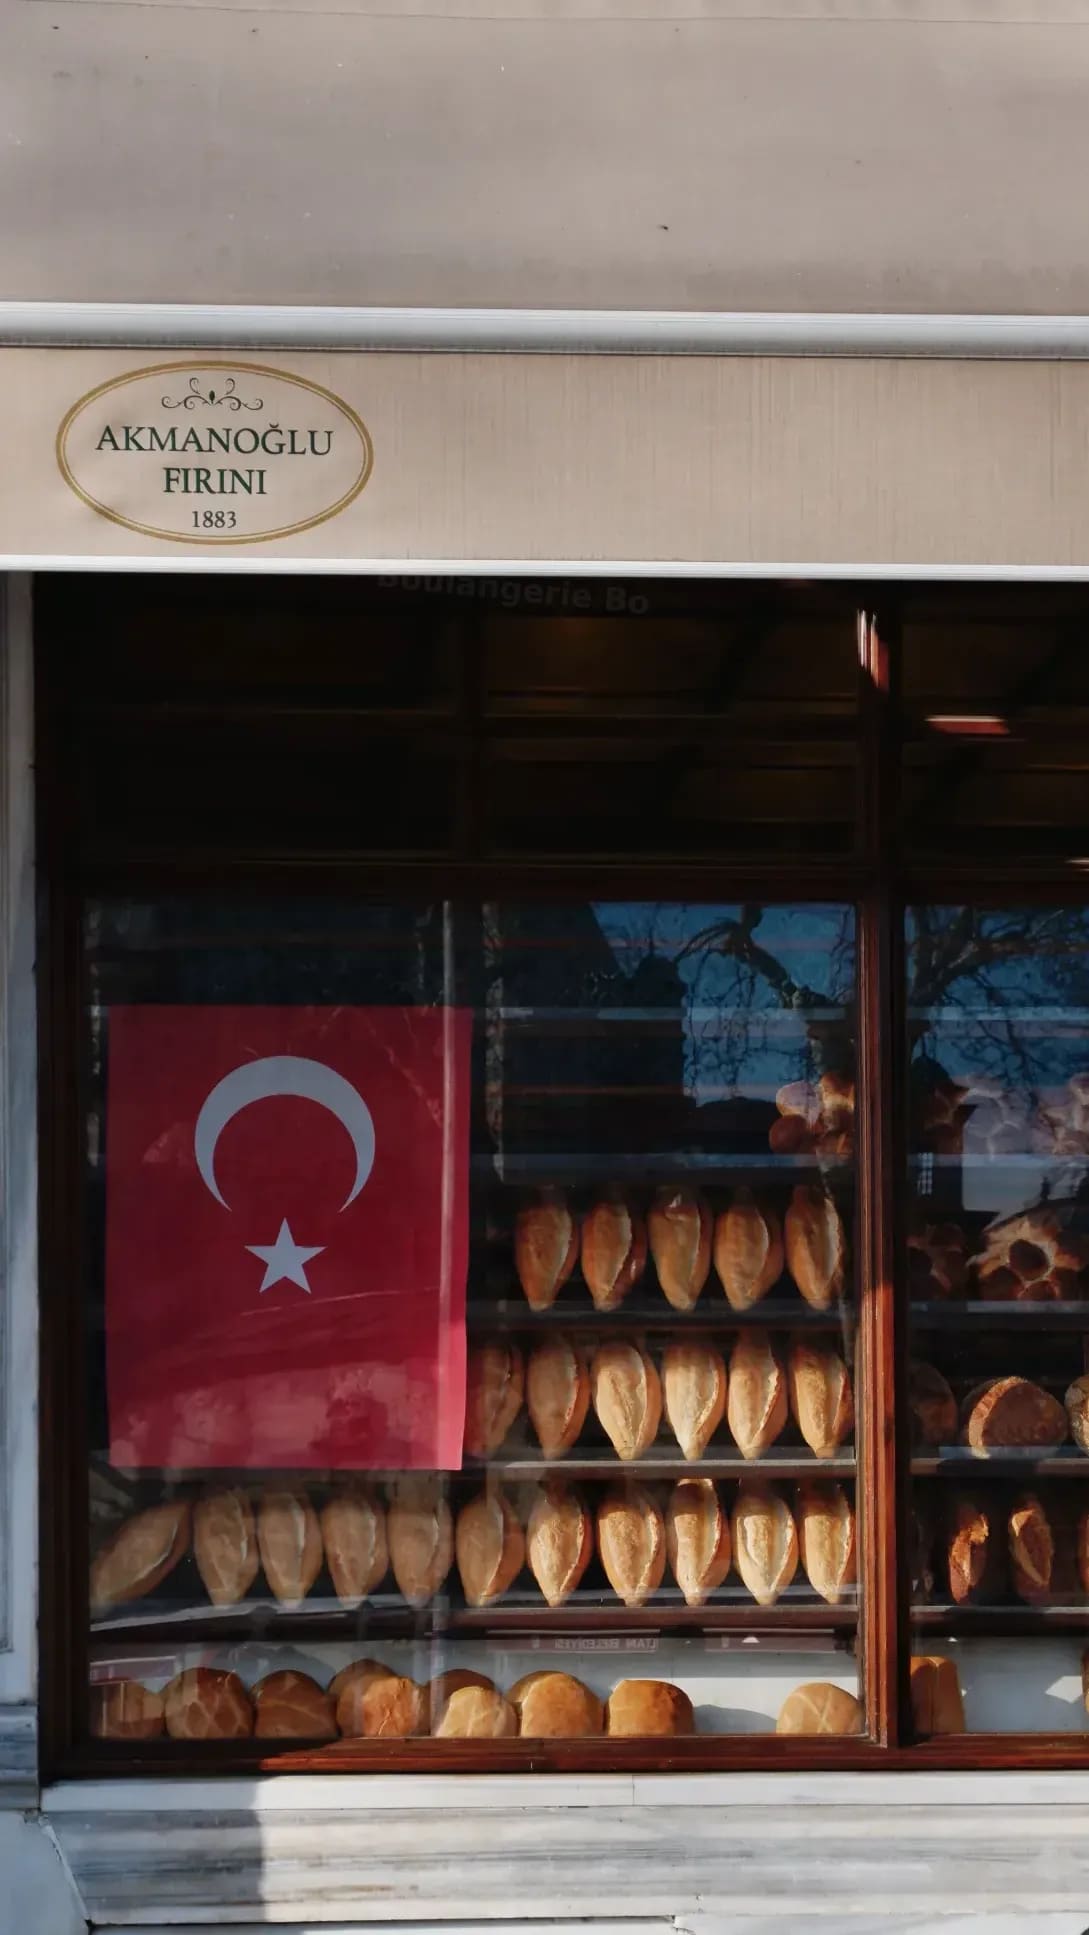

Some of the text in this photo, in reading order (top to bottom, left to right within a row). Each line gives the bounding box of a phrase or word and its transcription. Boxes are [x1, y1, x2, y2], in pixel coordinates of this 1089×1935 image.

[95, 423, 334, 456] AKMANOĞLU
[163, 467, 267, 495] FIRINI
[192, 510, 237, 528] 1883
[606, 587, 648, 614] Bo
